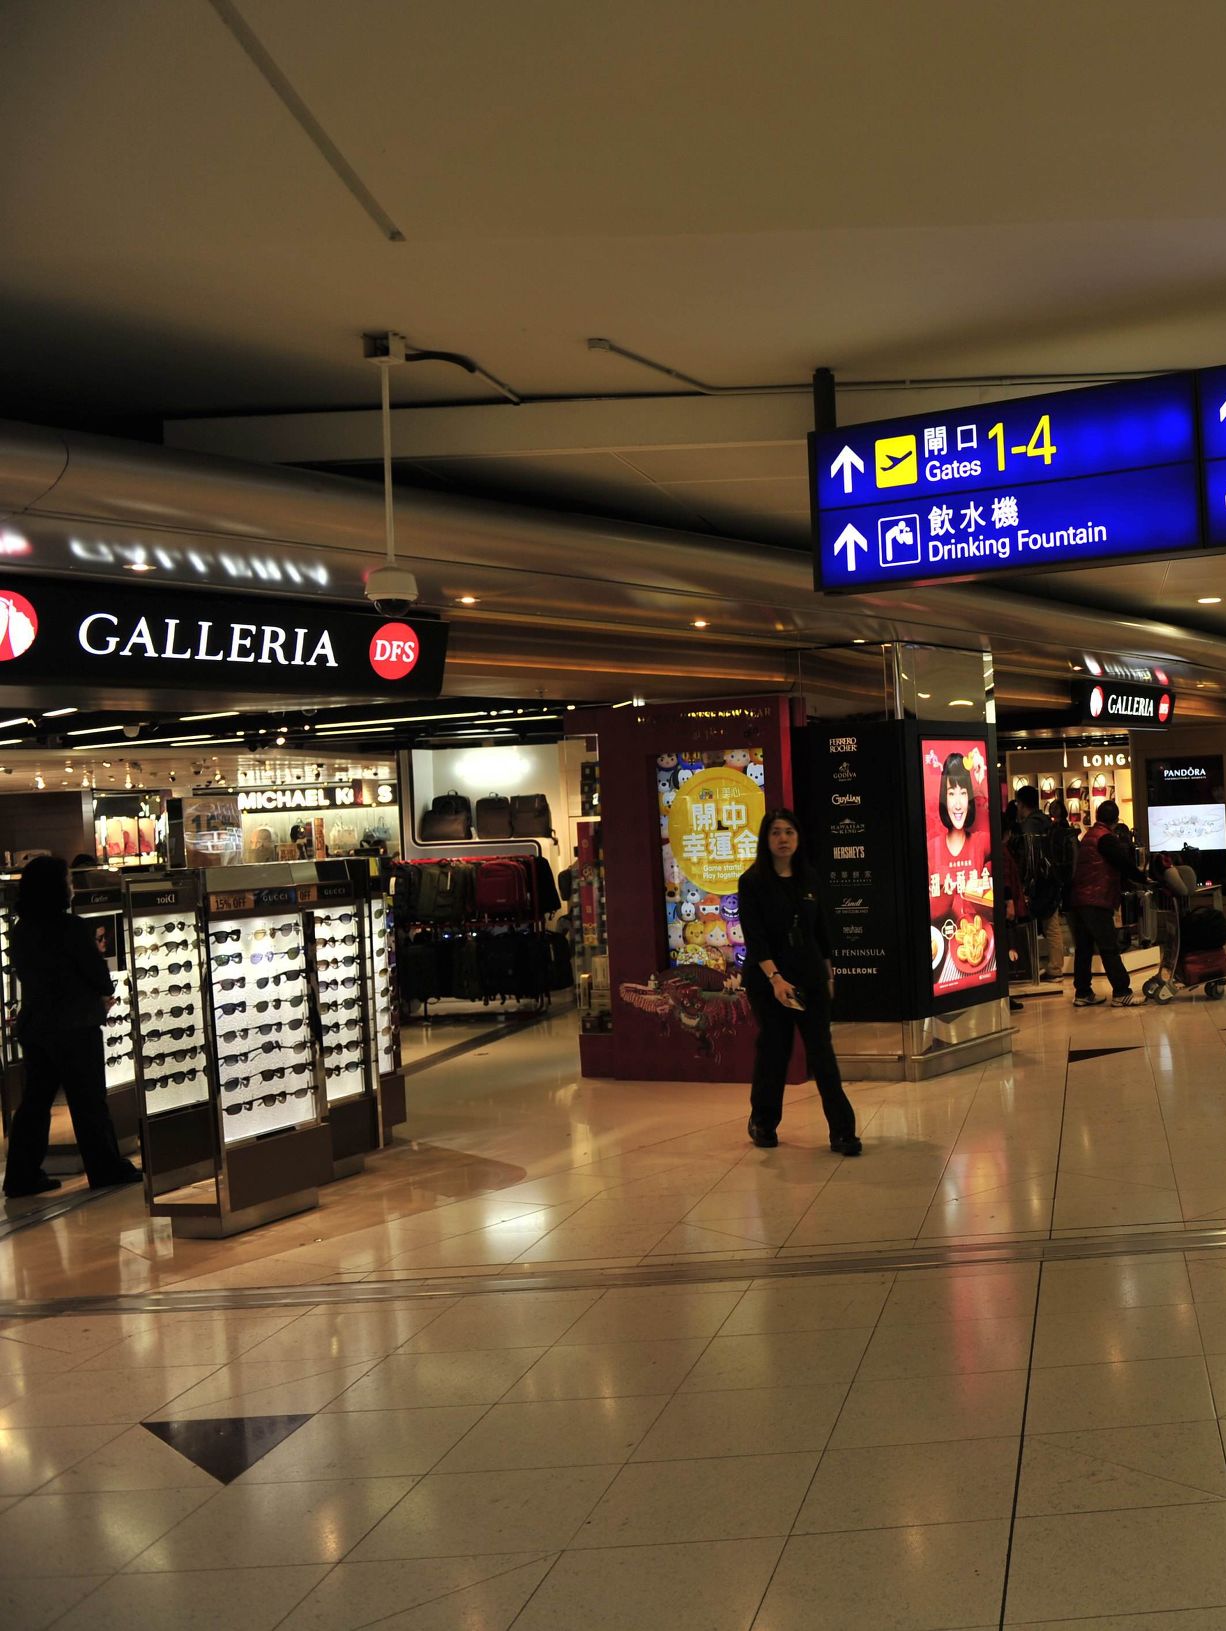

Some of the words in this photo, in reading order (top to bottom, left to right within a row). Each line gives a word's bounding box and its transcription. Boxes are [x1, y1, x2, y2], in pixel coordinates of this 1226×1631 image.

[923, 424, 978, 458] 閘口
[988, 414, 1057, 472] 1-4
[925, 458, 982, 482] Gates
[927, 495, 1019, 537] 飲水機
[928, 535, 1011, 562] Drinking
[1017, 521, 1107, 552] Fountain
[78, 613, 339, 667] GALLERIA
[373, 639, 415, 664] DFS
[1107, 694, 1154, 717] GALLERIA
[829, 737, 857, 746] FERRERO
[829, 744, 857, 753] ROCHER
[1082, 753, 1131, 768] LONG
[237, 788, 331, 811] MICHAEL
[692, 802, 748, 831] 開中
[682, 829, 759, 864] 幸運金
[833, 846, 865, 860] HERSHEY'S
[262, 893, 289, 903] GUCCI
[323, 887, 346, 897] GUCCI
[215, 898, 232, 910] 15%
[841, 948, 886, 957] PENINSULA
[832, 967, 878, 976] TOBLERONE
